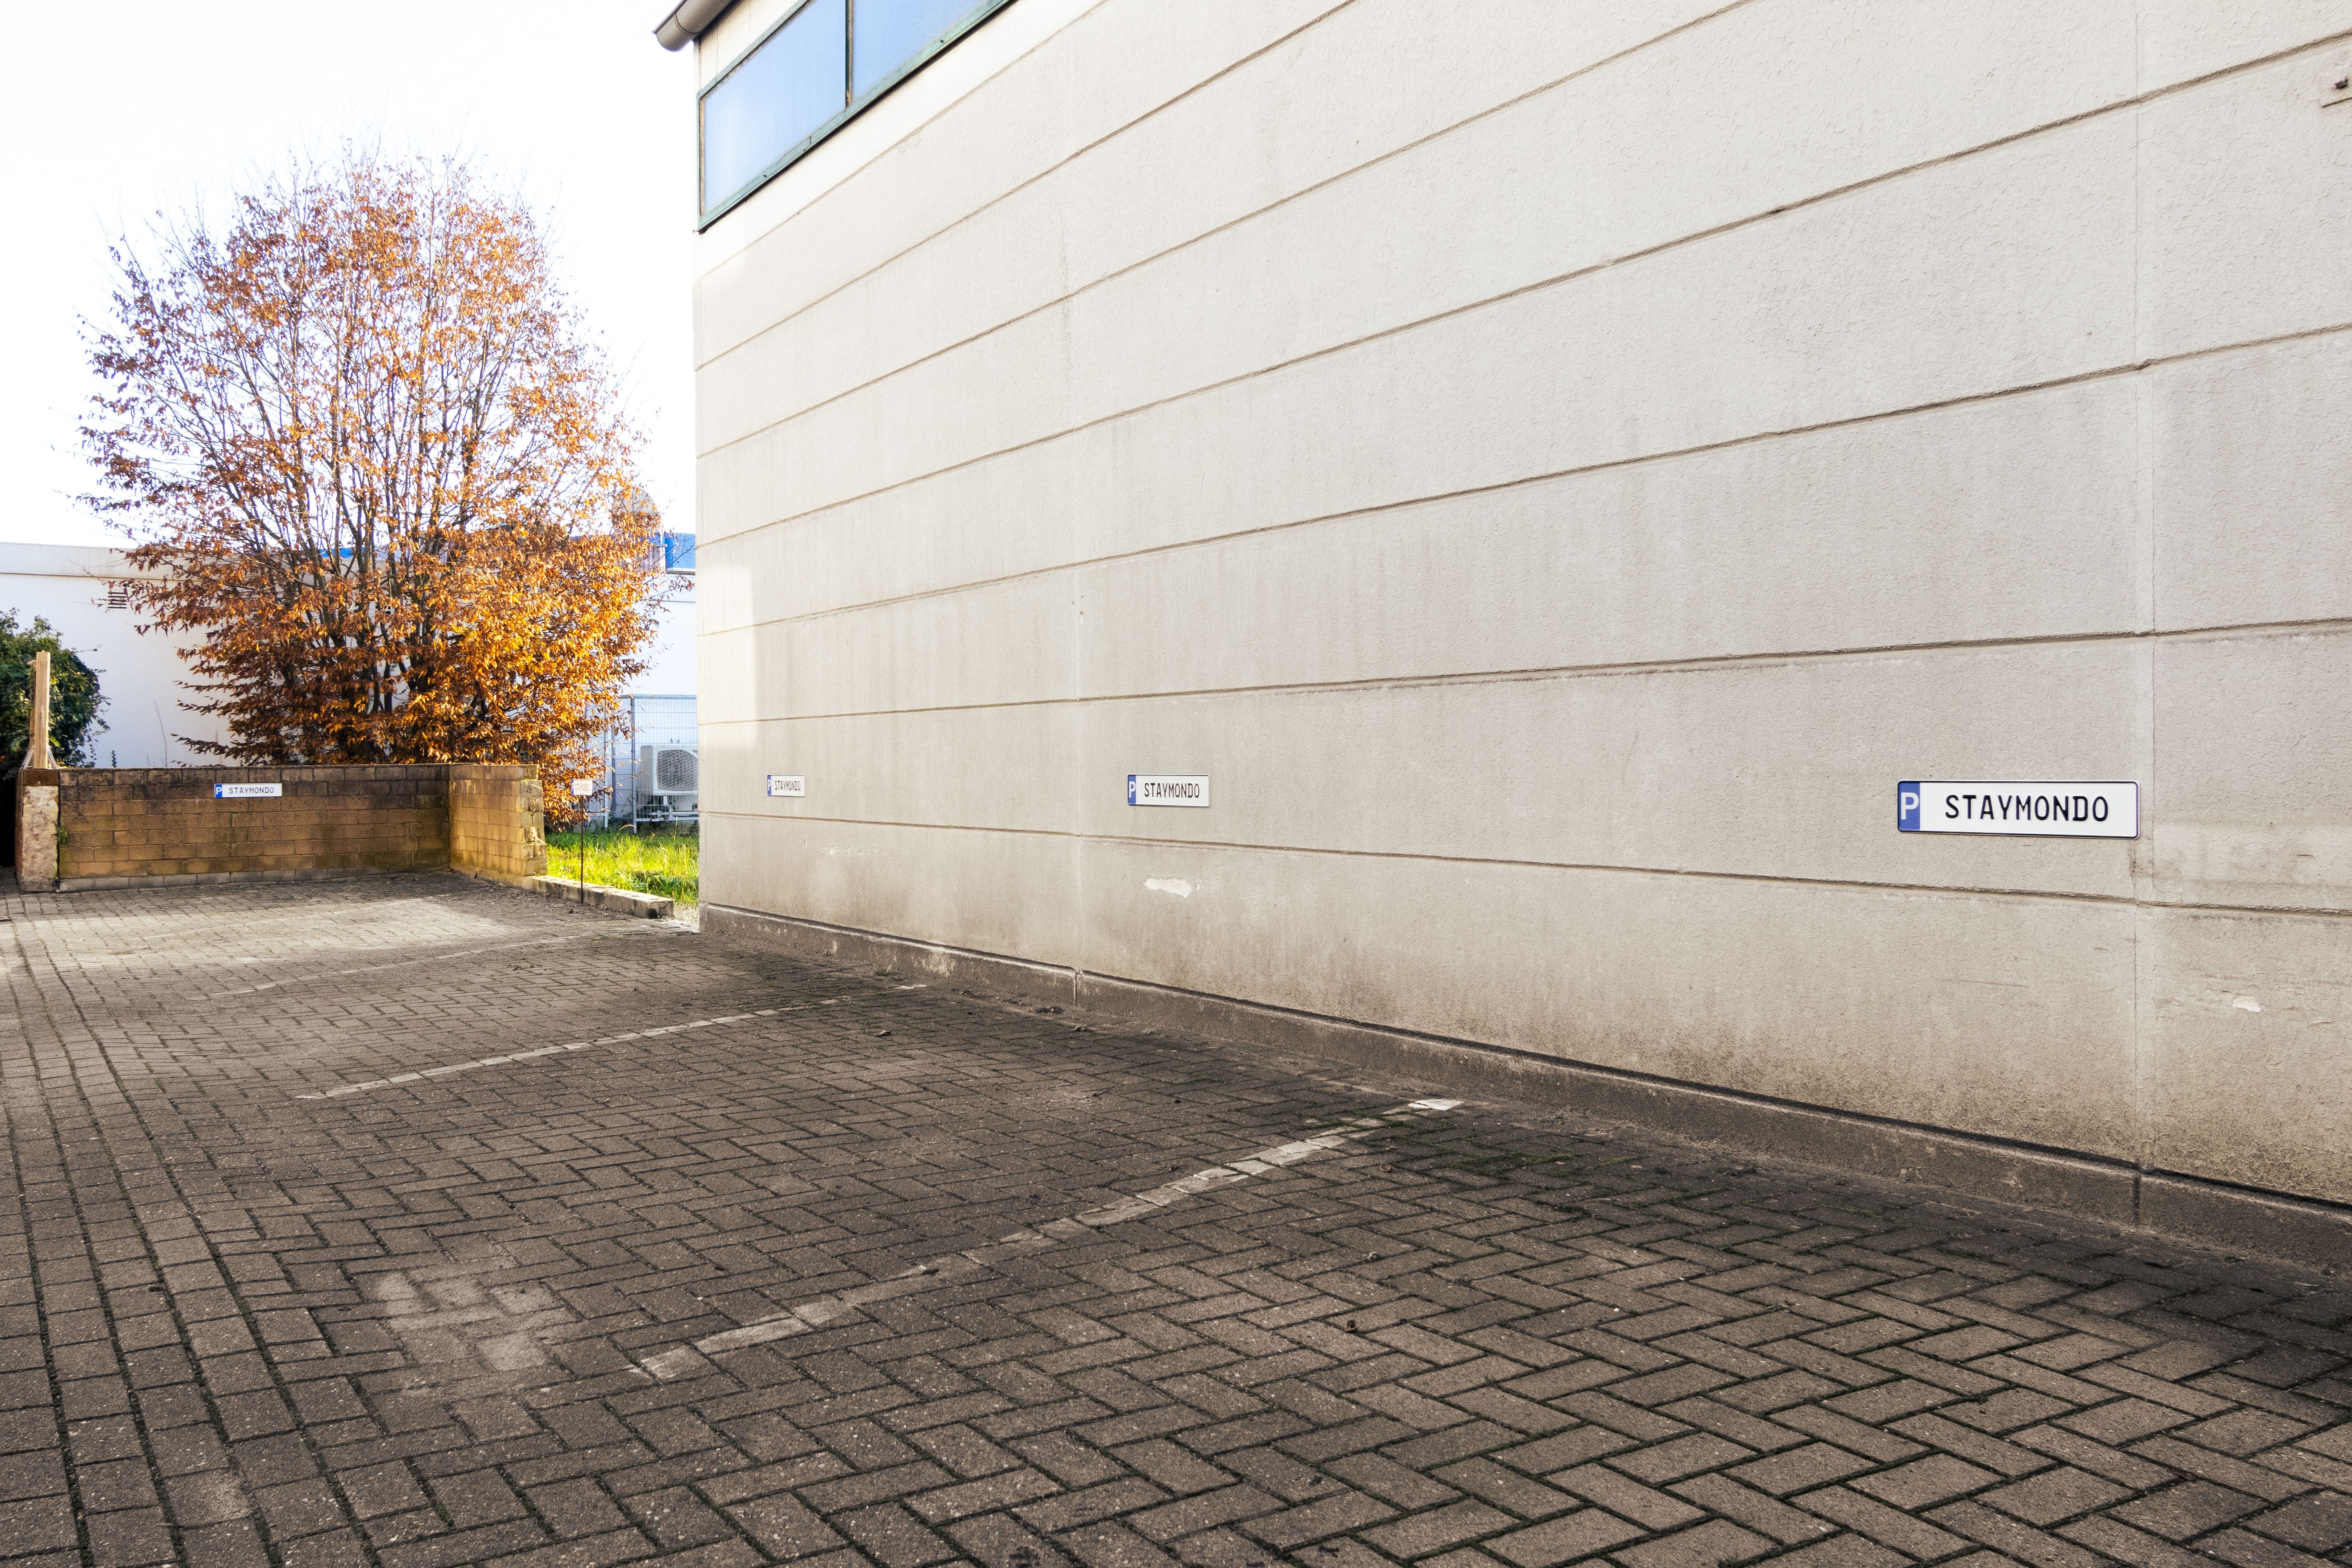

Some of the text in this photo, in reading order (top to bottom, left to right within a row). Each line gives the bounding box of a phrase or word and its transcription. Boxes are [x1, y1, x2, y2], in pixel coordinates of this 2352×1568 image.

[768, 779, 800, 791] P STAYMONDO
[1129, 781, 1200, 798] P STAYMONDO
[1900, 792, 2109, 822] P STAYMONDO
